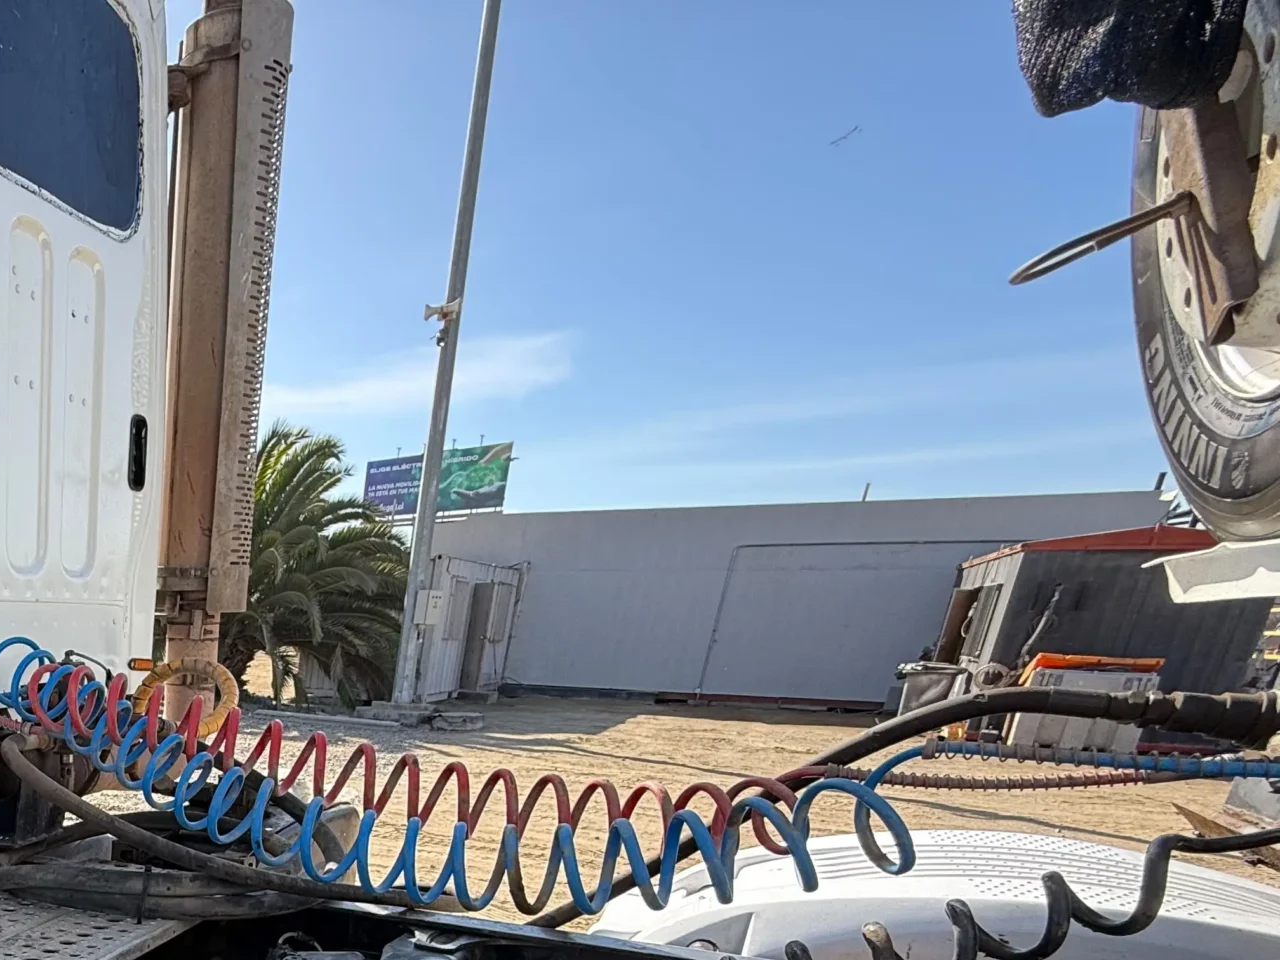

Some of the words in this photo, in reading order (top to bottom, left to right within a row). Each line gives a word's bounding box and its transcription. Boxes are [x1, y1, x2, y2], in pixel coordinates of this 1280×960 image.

[370, 466, 391, 474] ELIGE
[391, 462, 422, 471] ELÉCTR
[376, 482, 395, 490] NUEVA
